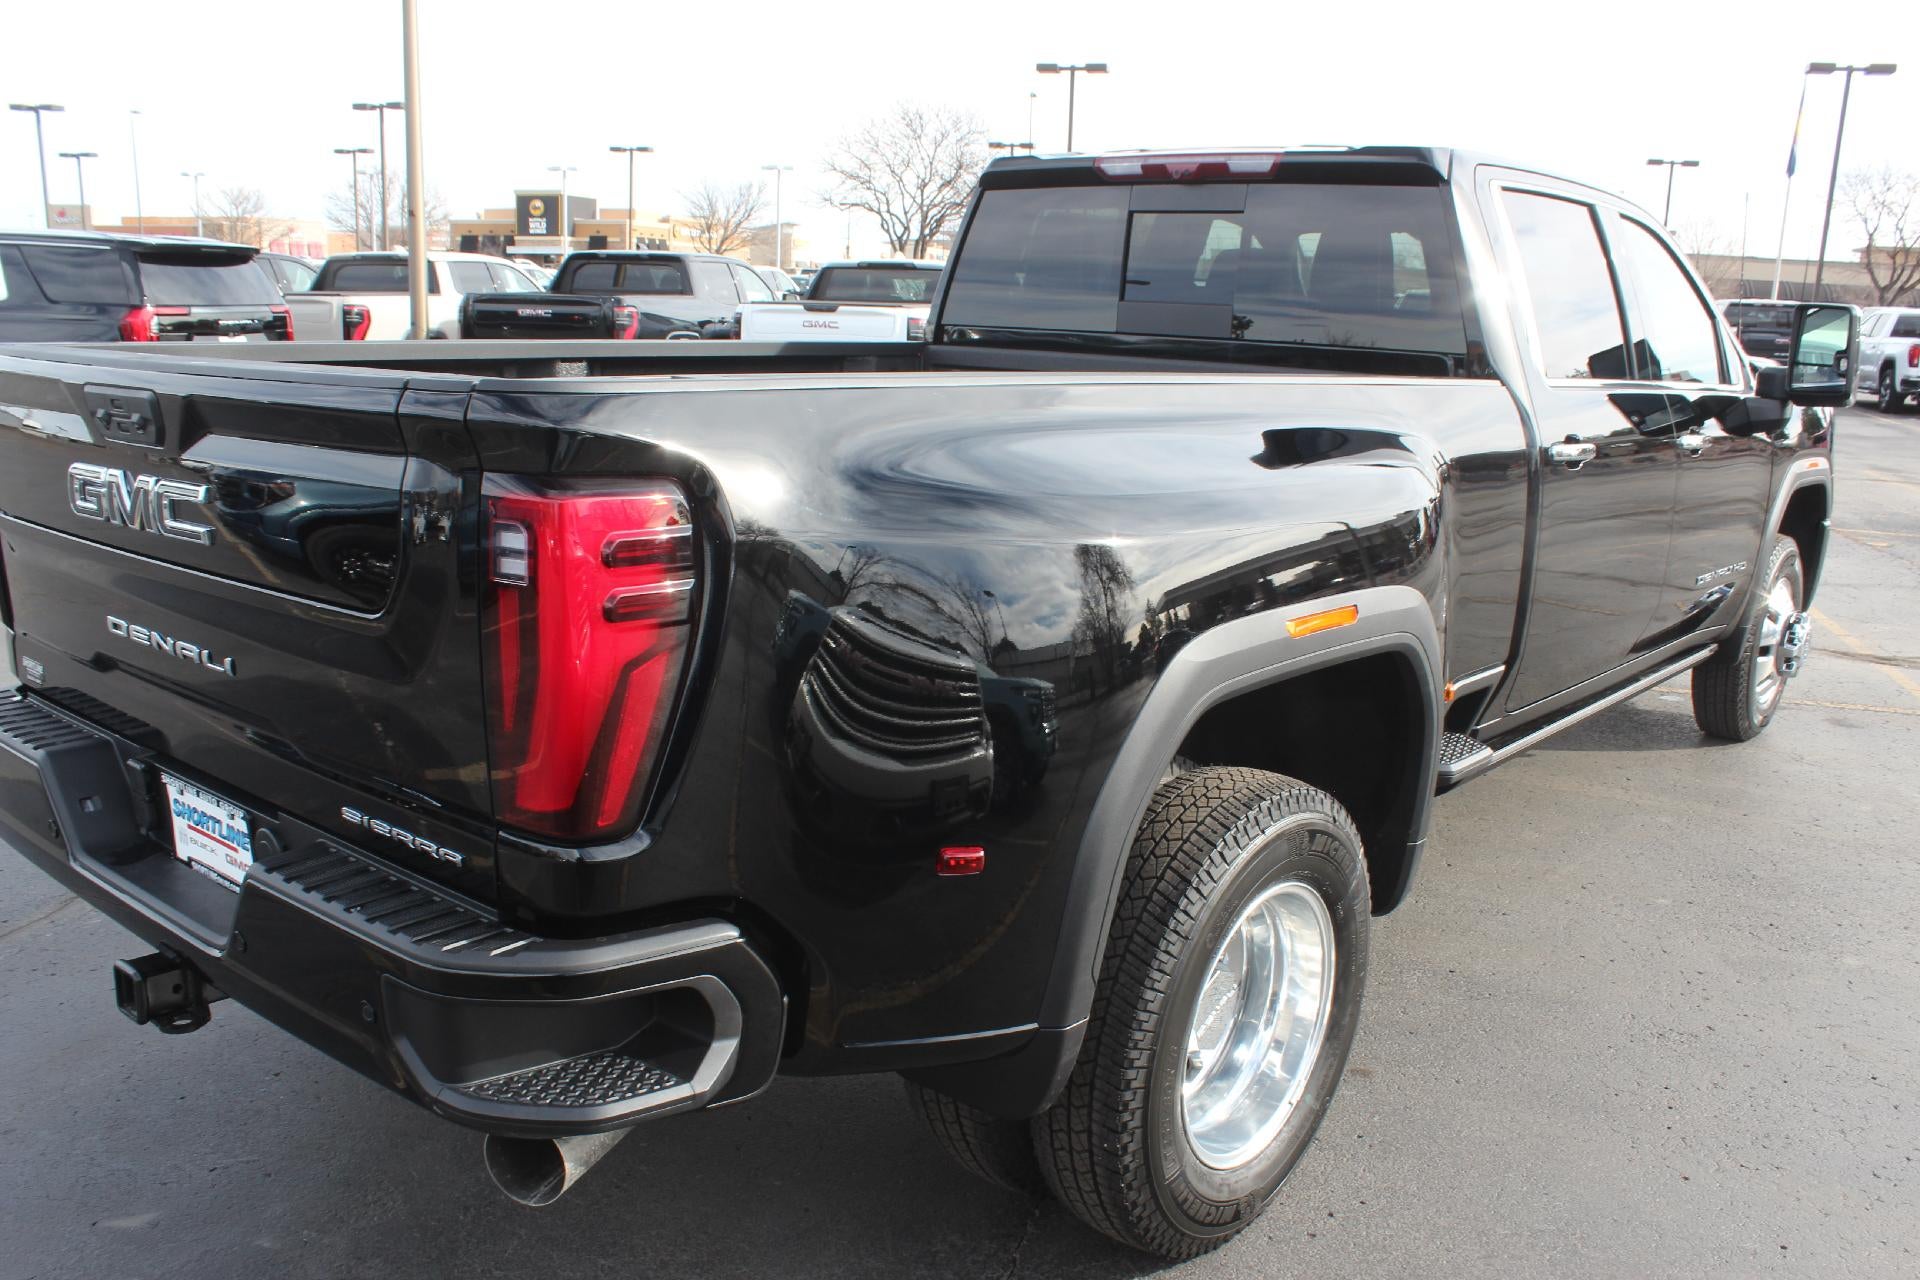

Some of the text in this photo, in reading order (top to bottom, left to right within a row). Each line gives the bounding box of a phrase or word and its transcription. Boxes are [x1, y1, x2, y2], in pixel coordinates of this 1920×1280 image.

[517, 308, 553, 318] GMC
[802, 320, 840, 330] GMC
[67, 461, 216, 546] GMC
[106, 614, 237, 678] DENALI
[172, 798, 251, 853] SHORTLINE
[340, 806, 464, 868] SIERRA
